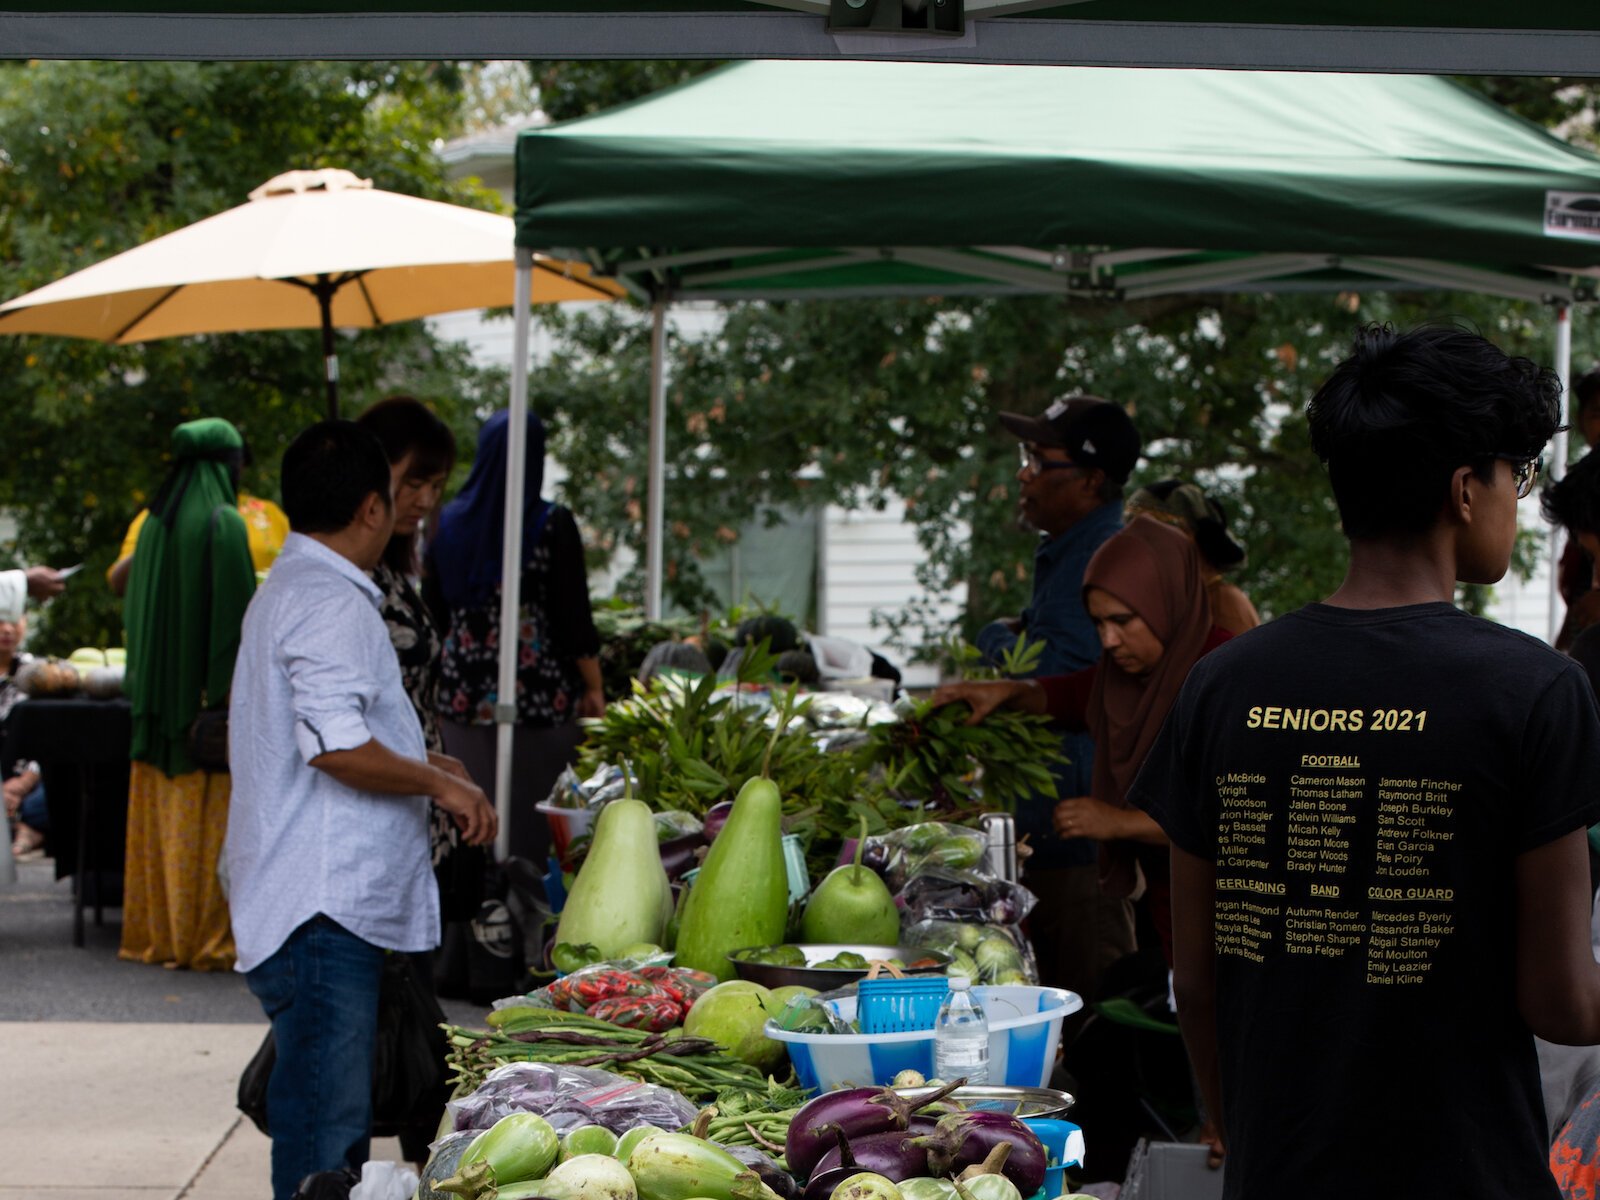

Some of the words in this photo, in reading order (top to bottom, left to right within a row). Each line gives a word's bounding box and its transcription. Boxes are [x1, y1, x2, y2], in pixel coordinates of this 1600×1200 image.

[1247, 706, 1364, 732] SENIORS
[1370, 709, 1427, 732] 2021
[1301, 755, 1361, 768] FOOTBALL
[1227, 773, 1266, 783] McBride
[1291, 775, 1334, 786] Cameron
[1336, 776, 1365, 786] Mason
[1379, 777, 1418, 788] Jamonte
[1421, 779, 1462, 791] Fincher
[1290, 787, 1329, 798] Thomas
[1331, 789, 1363, 799] Latham
[1378, 790, 1422, 802] Raymond
[1425, 792, 1448, 803] Britt
[1222, 798, 1266, 808] Woodson
[1289, 800, 1316, 810] Jalen
[1319, 801, 1347, 811] Boone
[1244, 810, 1273, 822] Hagler
[1378, 802, 1409, 814] Joseph
[1411, 804, 1453, 818] Burkley
[1289, 812, 1319, 822] Kelvin
[1322, 813, 1356, 823] Williams
[1378, 815, 1395, 825] Sam
[1397, 816, 1425, 827] Scott
[1219, 824, 1230, 834] ey
[1233, 821, 1266, 832] Bassett
[1288, 824, 1318, 835] Micah
[1321, 825, 1341, 838] Kelly
[1377, 827, 1410, 838] Andrew
[1413, 829, 1454, 840] Folkner
[1218, 836, 1229, 844] es
[1233, 834, 1265, 845] Rhodes
[1288, 836, 1321, 847] Mason
[1324, 838, 1349, 849] Moore
[1221, 846, 1249, 855] Miller
[1398, 841, 1435, 852] Garcia
[1288, 848, 1317, 859] Oscar
[1320, 850, 1348, 861] Woods
[1394, 853, 1424, 865] Poiry
[1228, 857, 1269, 869] Carpenter
[1287, 861, 1316, 873] Brady
[1319, 863, 1347, 874] Hunter
[1376, 865, 1387, 875] Jon
[1389, 866, 1430, 876] Louden
[1216, 879, 1286, 894] EERLEADING
[1310, 884, 1340, 897] BAND
[1368, 887, 1403, 900] COLOR
[1406, 888, 1454, 900] GUARD
[1216, 912, 1249, 922] ercedes
[1250, 914, 1260, 926] Lee
[1286, 907, 1322, 918] Autumn
[1324, 909, 1359, 919] Render
[1371, 910, 1415, 922] Mercedes
[1418, 911, 1452, 924] Byerly
[1286, 919, 1327, 930] Christian
[1329, 922, 1367, 932] Romero
[1371, 923, 1419, 934] Cassandra
[1423, 924, 1455, 934] Baker
[1286, 931, 1325, 943] Stephen
[1327, 933, 1361, 946] Sharpe
[1368, 936, 1397, 949] Abigail
[1400, 937, 1440, 949] Stanley
[1315, 945, 1345, 957] Felger
[1368, 948, 1384, 959] Kori
[1386, 949, 1428, 959] Moulton
[1367, 960, 1390, 974] Emily
[1392, 962, 1432, 973] Leazier
[1366, 973, 1394, 985] Daniel
[1396, 974, 1424, 985] Kline
